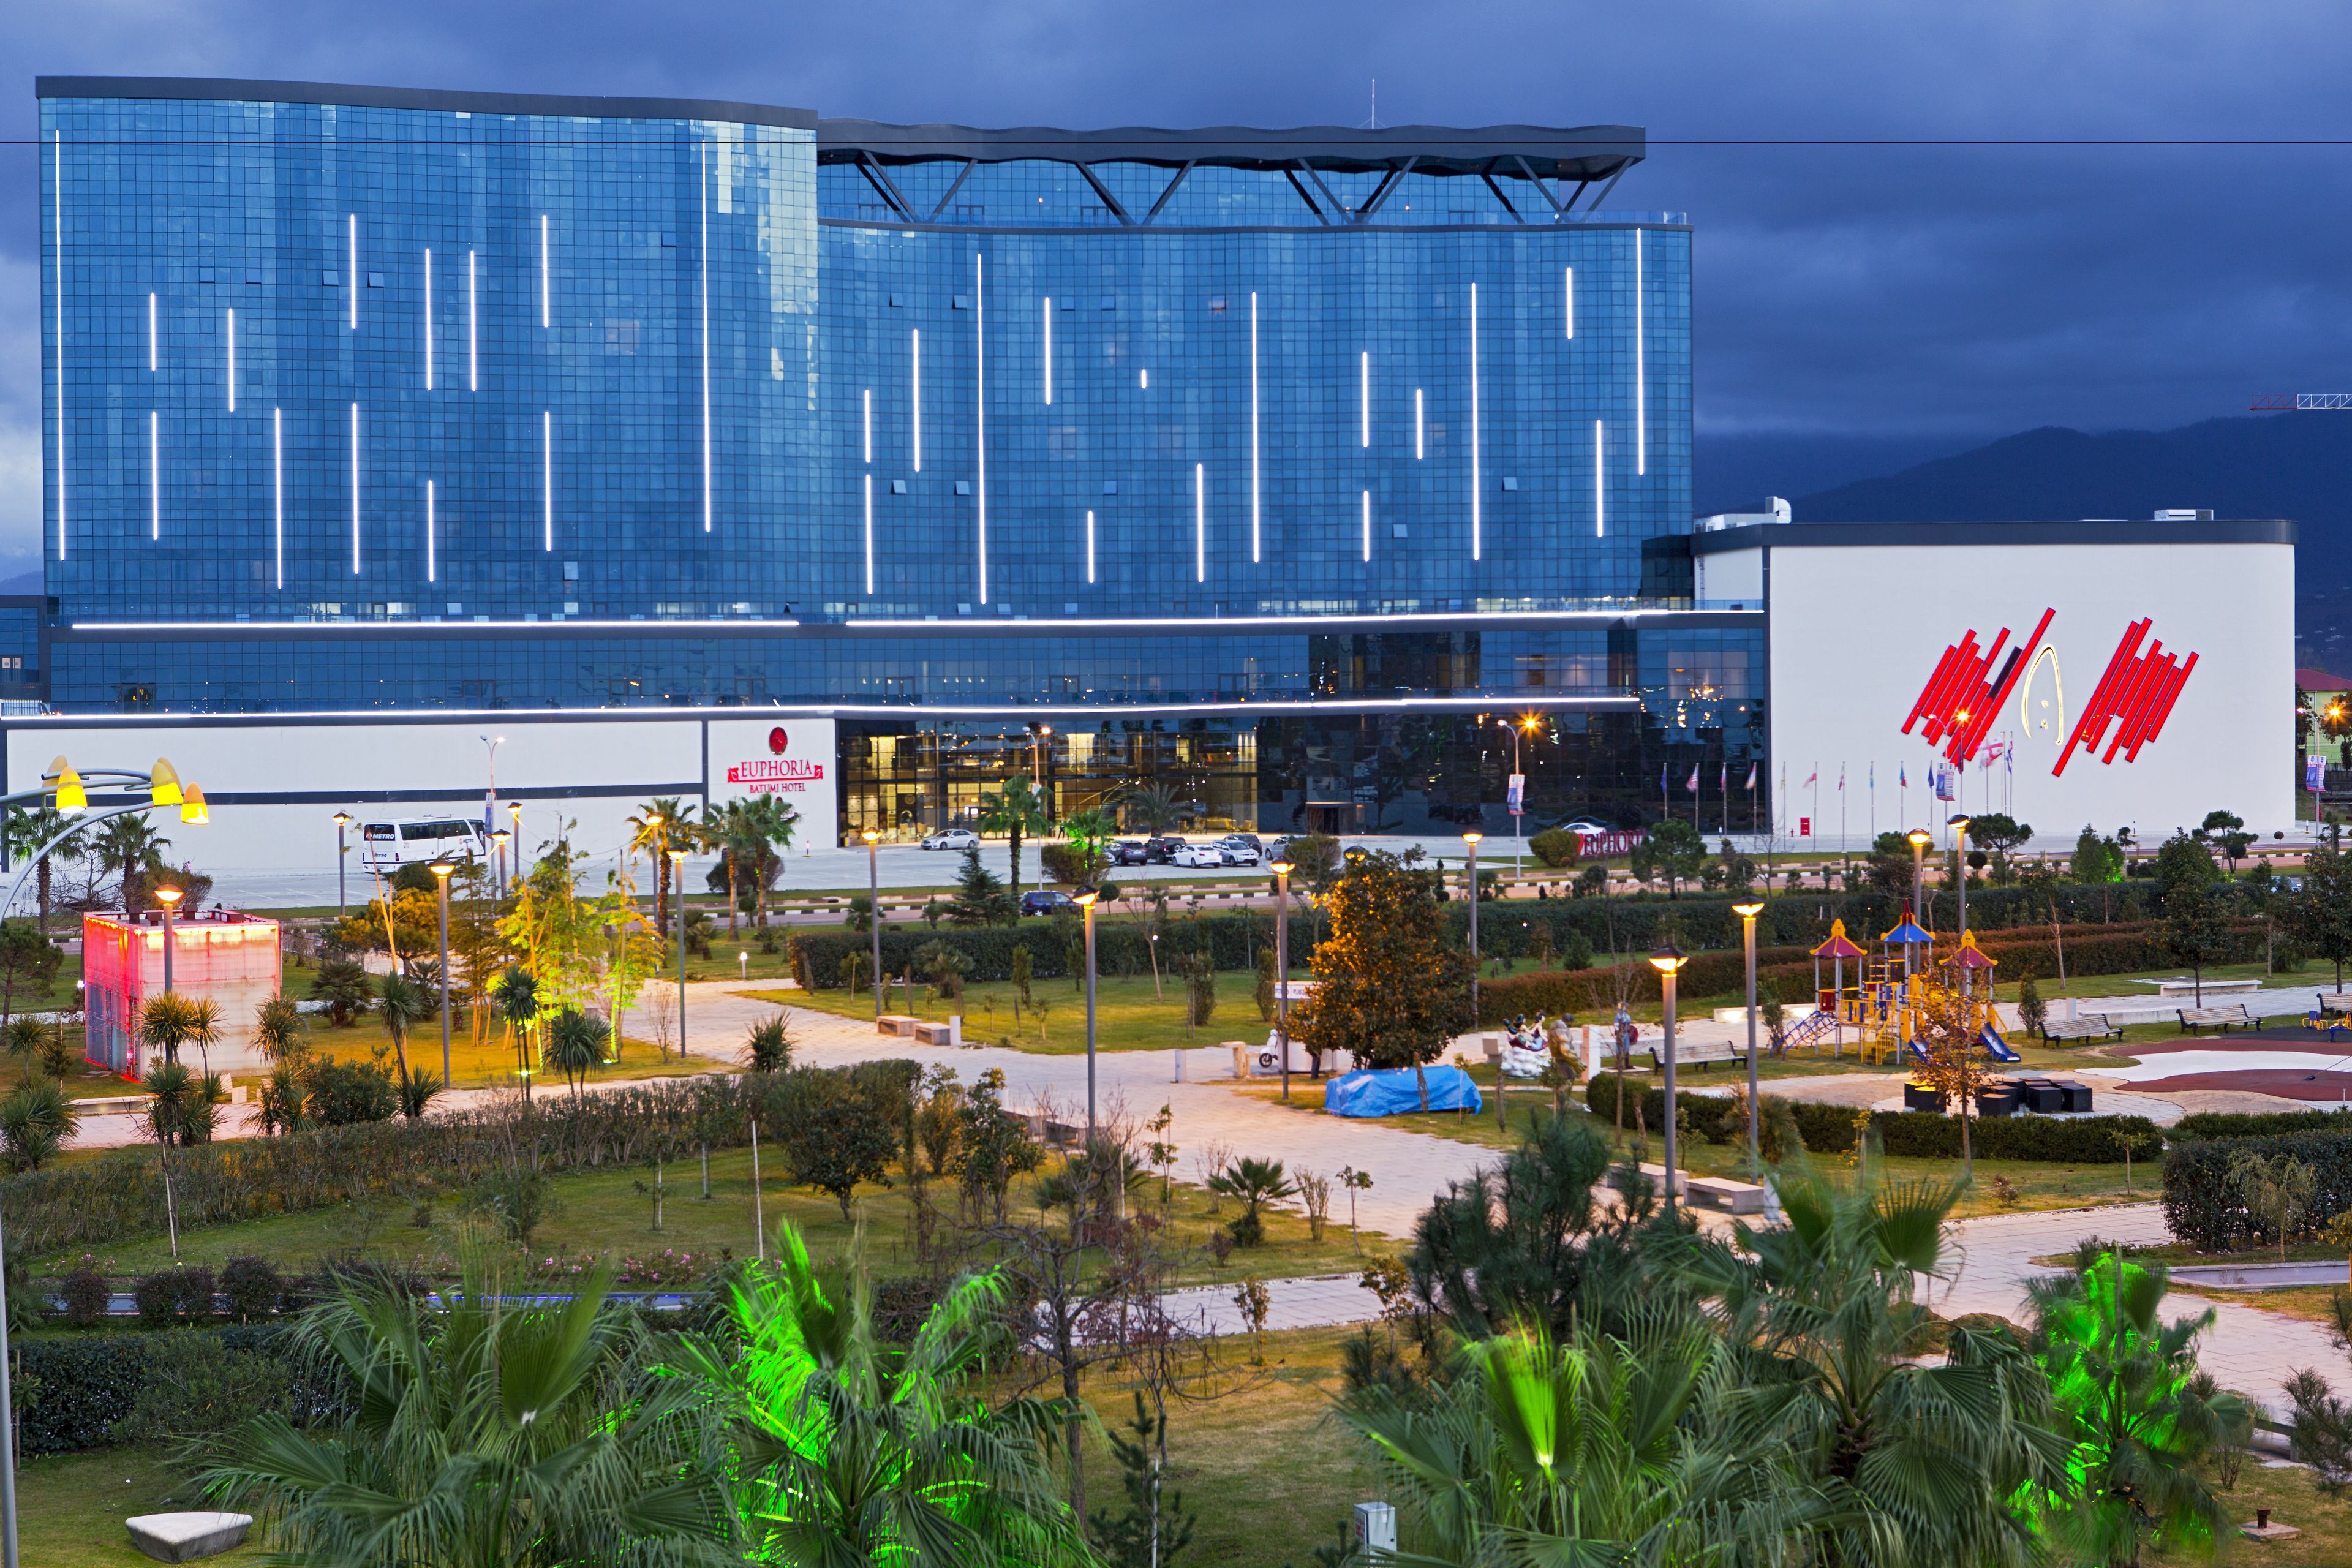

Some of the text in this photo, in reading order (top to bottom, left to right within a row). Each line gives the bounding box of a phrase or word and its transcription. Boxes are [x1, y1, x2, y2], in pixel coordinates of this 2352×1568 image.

[741, 760, 812, 777] EUPHORIA
[750, 783, 806, 793] BATUMI HOTEL
